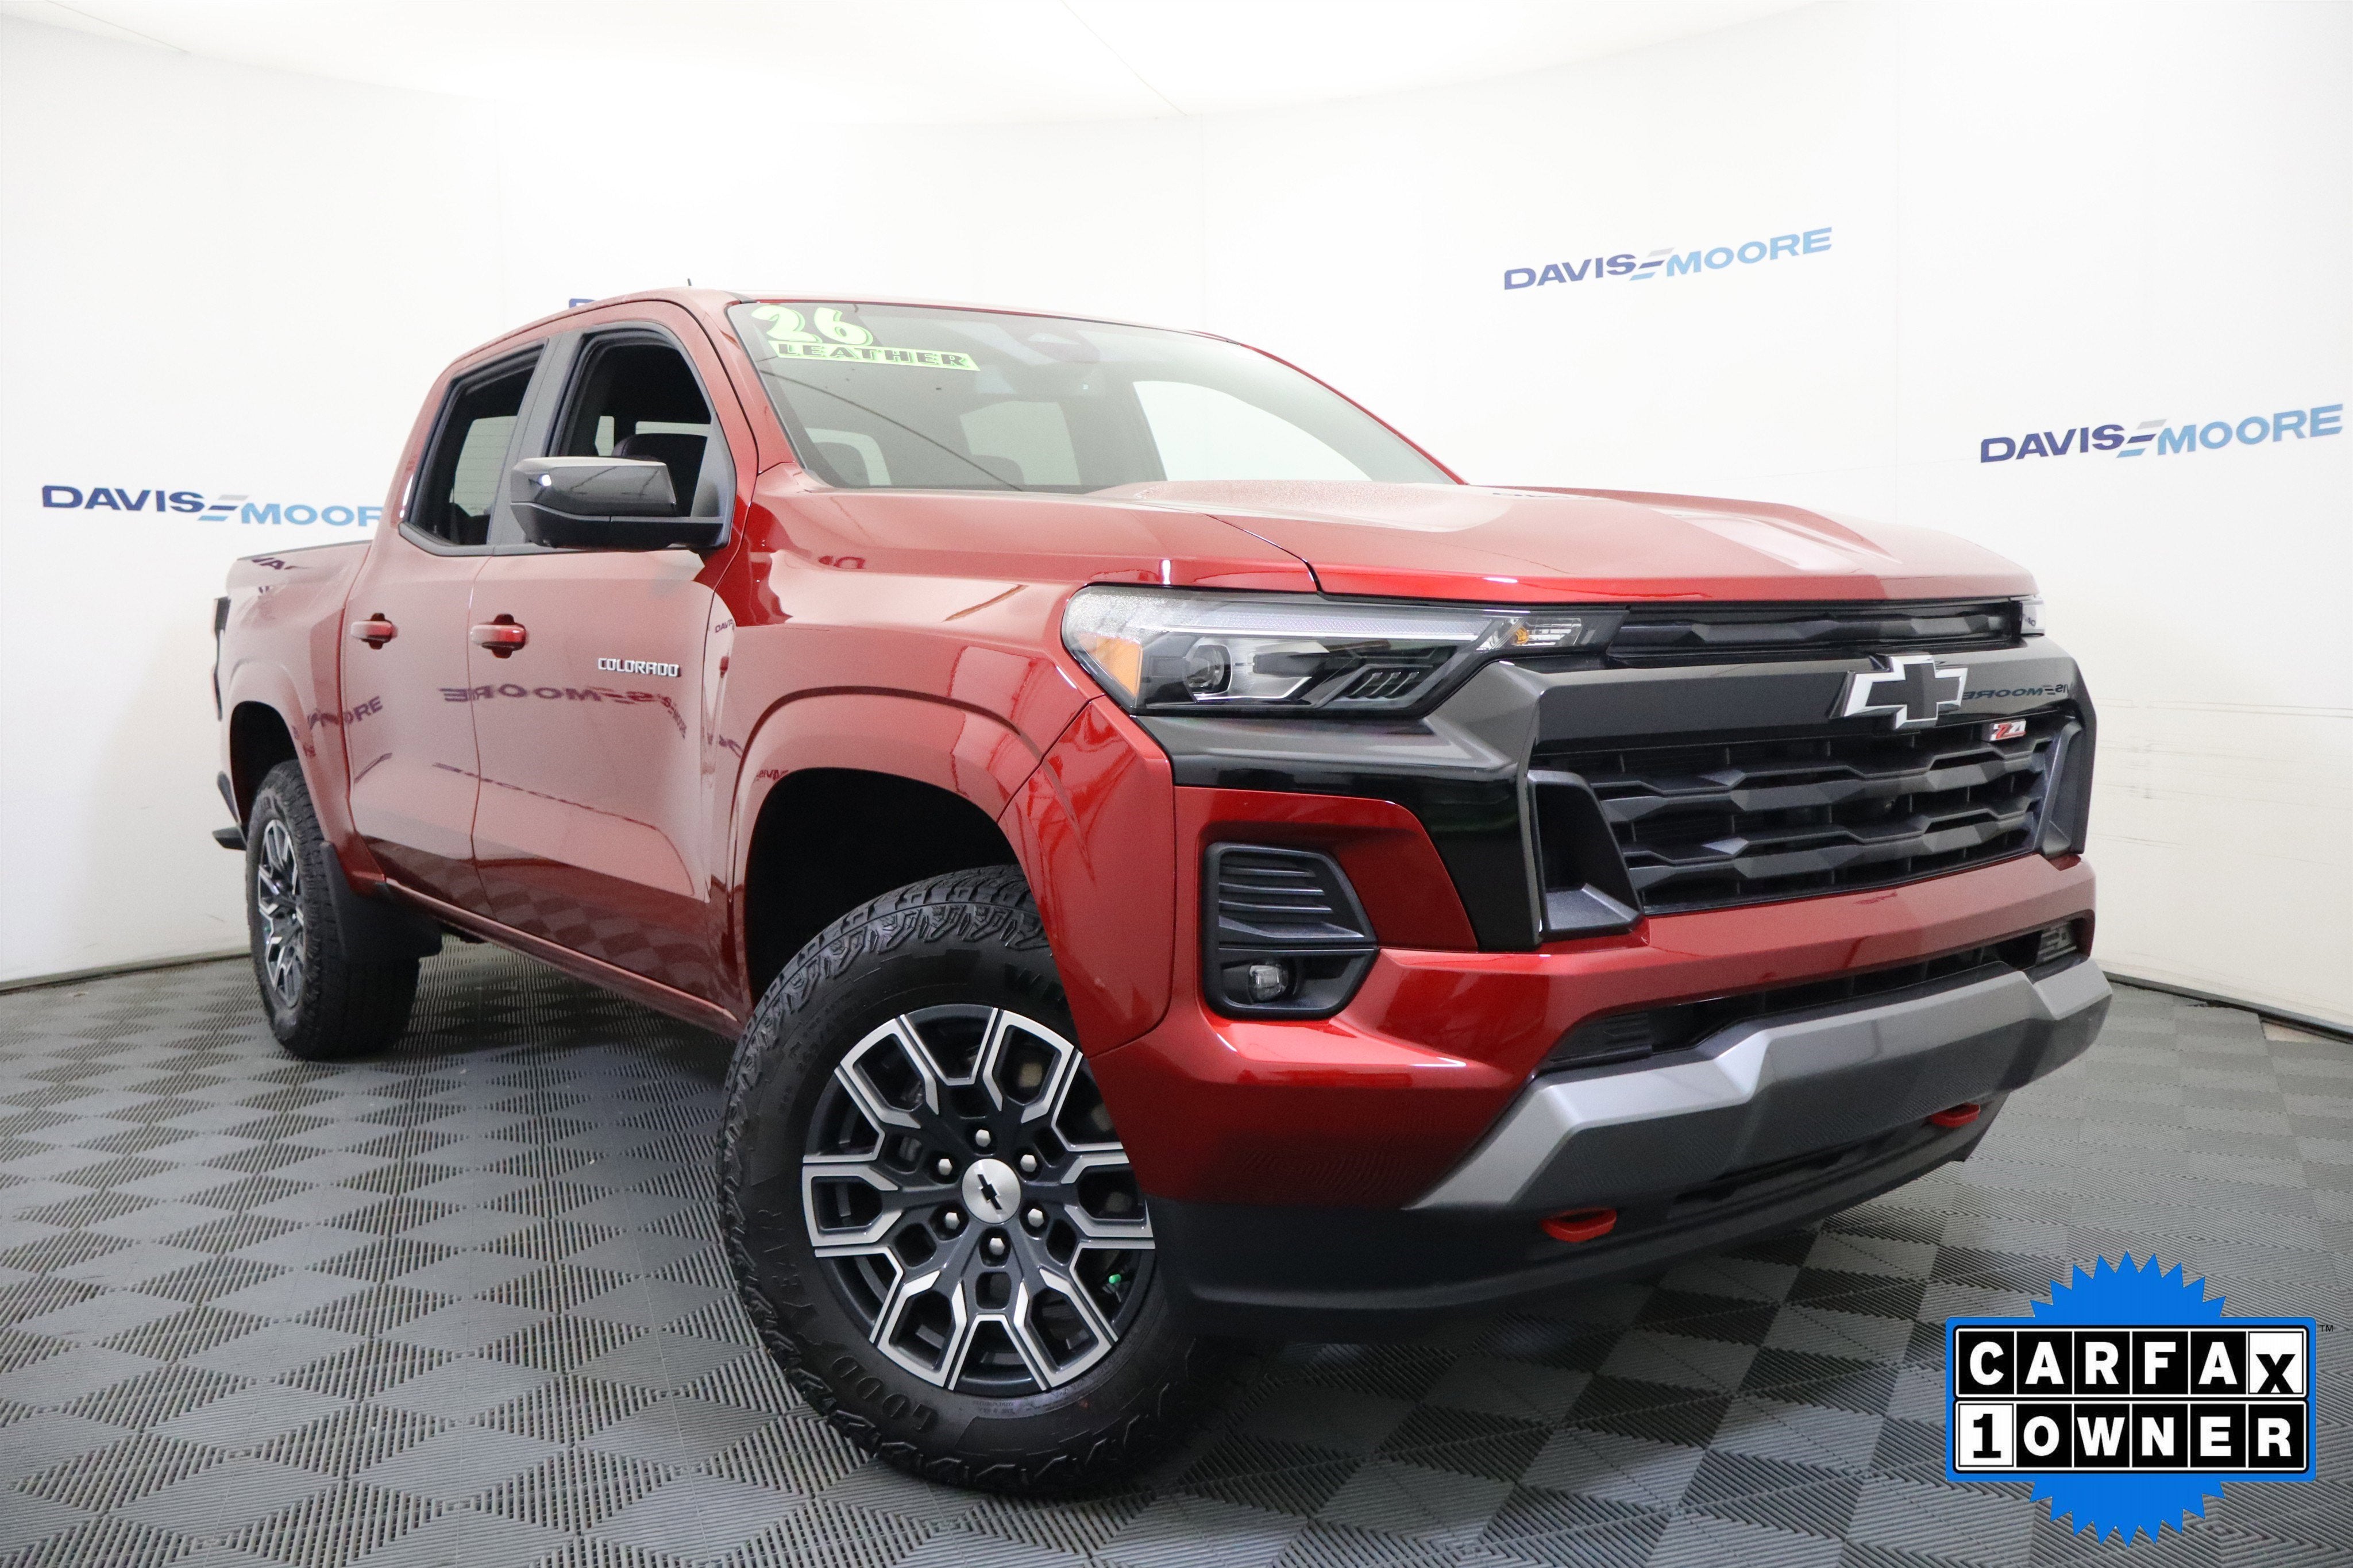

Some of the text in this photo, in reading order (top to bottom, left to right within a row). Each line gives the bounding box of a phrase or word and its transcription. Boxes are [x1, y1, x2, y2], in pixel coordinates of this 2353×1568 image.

[1504, 226, 1833, 290] DAVIS MOORE
[751, 305, 873, 346] 26
[778, 343, 967, 368] LEATHER
[1980, 403, 2343, 464] DAVIS MOORE
[42, 485, 383, 527] DAVIS MOOR
[598, 658, 680, 677] COLORADO
